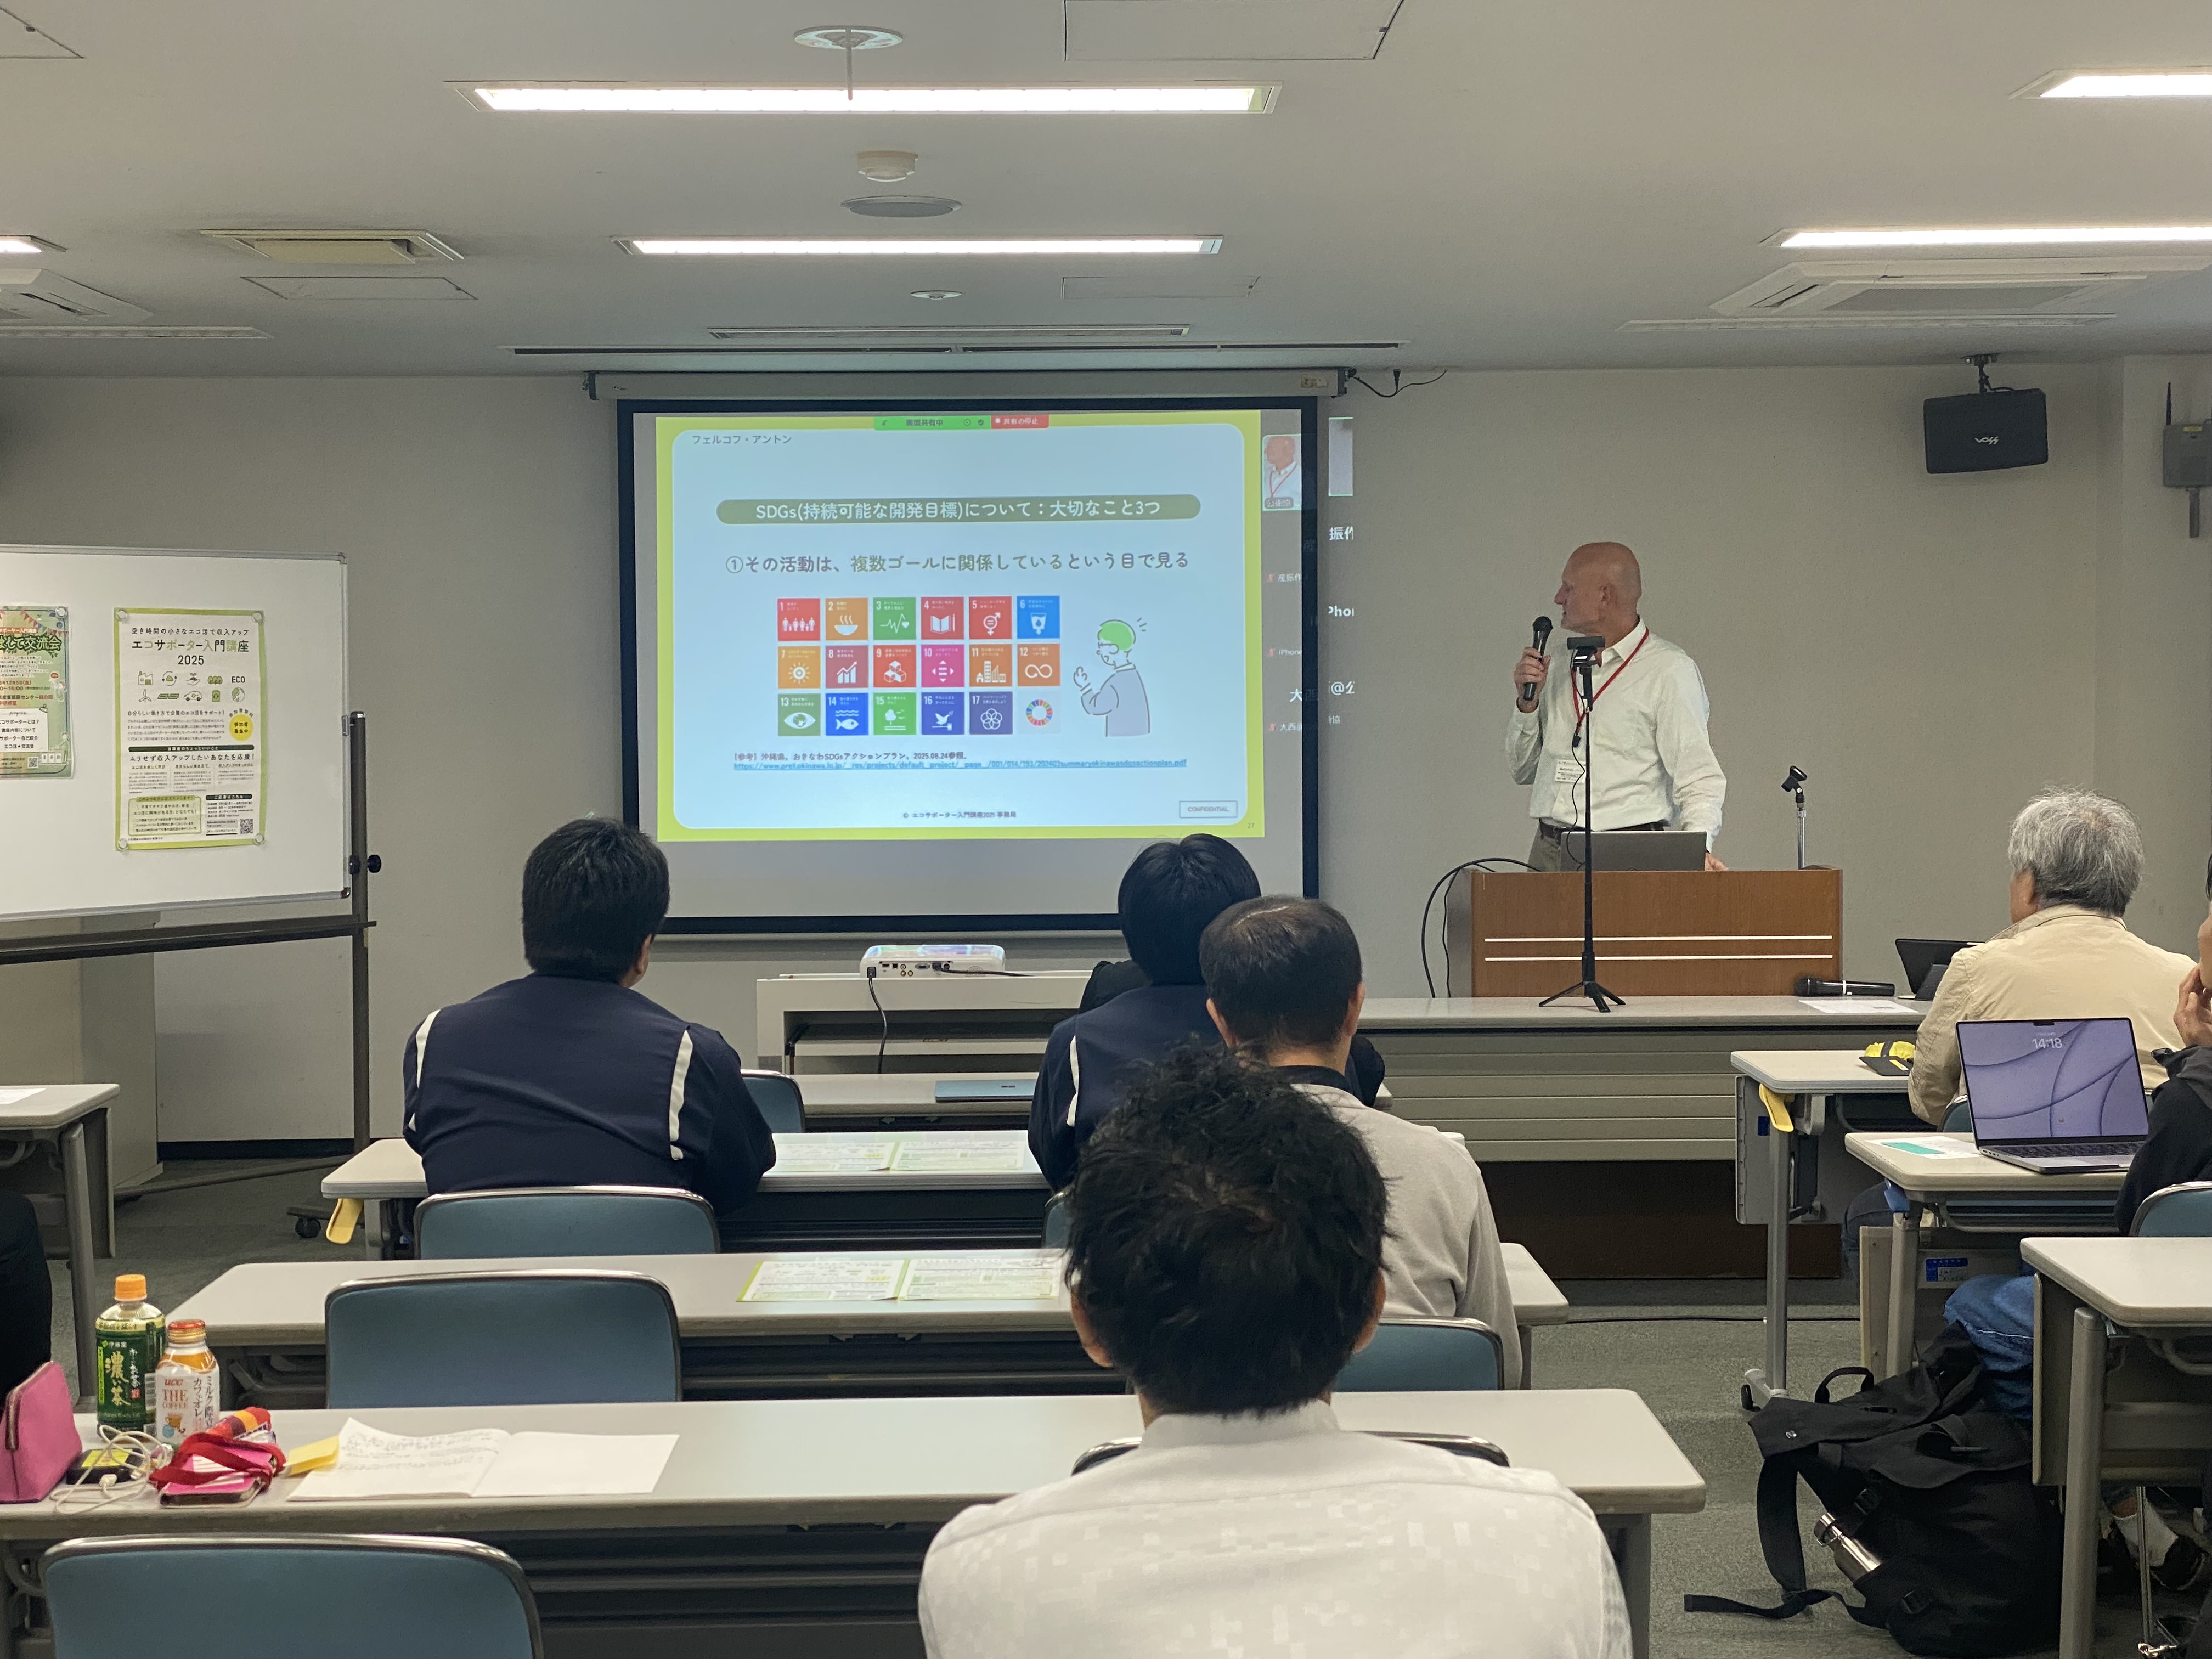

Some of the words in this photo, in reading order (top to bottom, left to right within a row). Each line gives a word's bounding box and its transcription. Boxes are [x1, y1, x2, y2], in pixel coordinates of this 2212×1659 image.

[692, 435, 792, 444] フェルコフ・アントン
[780, 602, 784, 611] 1
[828, 601, 834, 611] 2
[876, 601, 882, 610] 3
[924, 600, 929, 610] 4
[972, 600, 977, 610] 5
[1020, 600, 1025, 609] 6
[132, 639, 250, 653] エコサポーター入門講座
[781, 650, 786, 658] 7
[828, 649, 834, 658] 8
[876, 648, 882, 658] 9
[923, 648, 933, 657] 10
[972, 647, 979, 657] 11
[1019, 647, 1029, 656] 12
[178, 655, 205, 665] 2025
[780, 697, 789, 707] 13
[828, 697, 837, 706] 14
[876, 696, 885, 705] 15
[923, 696, 933, 705] 16
[972, 695, 980, 704] 17
[2032, 1037, 2063, 1049] 14:18
[104, 1351, 131, 1406] 濃い茶
[162, 1389, 188, 1401] THE
[193, 1378, 203, 1417] カフェオレ
